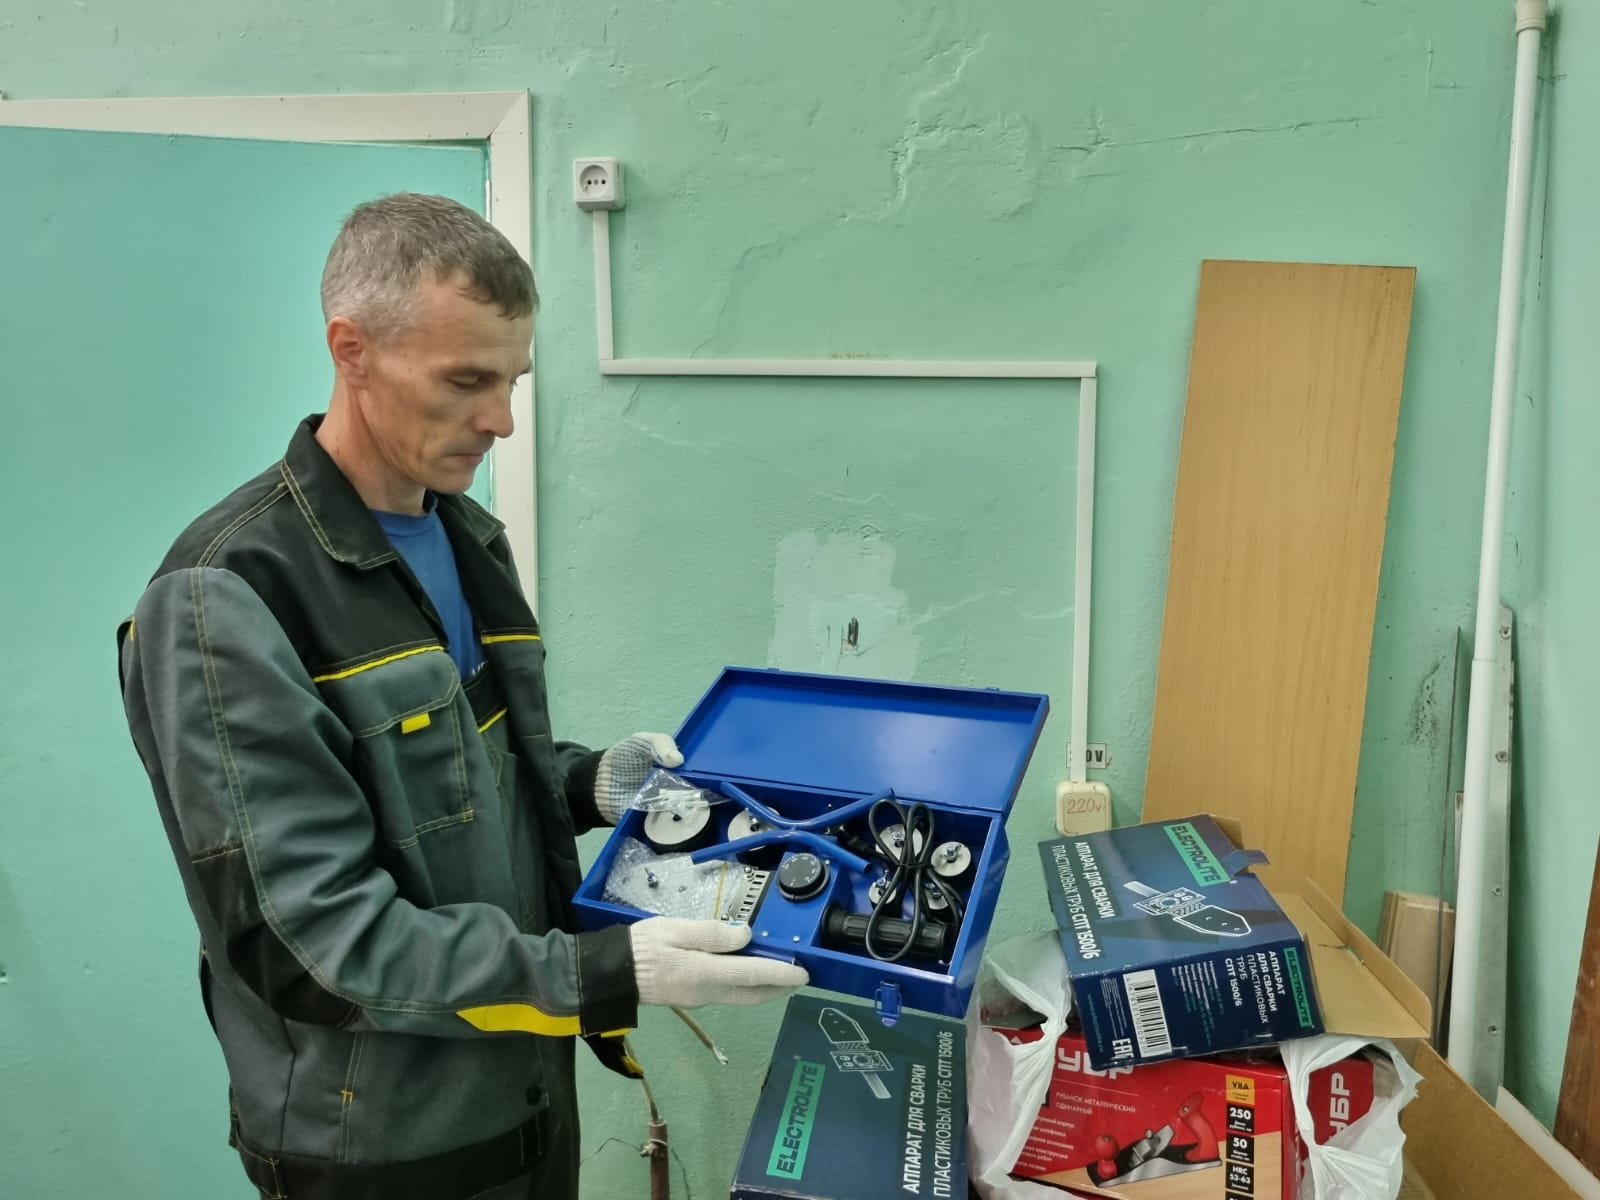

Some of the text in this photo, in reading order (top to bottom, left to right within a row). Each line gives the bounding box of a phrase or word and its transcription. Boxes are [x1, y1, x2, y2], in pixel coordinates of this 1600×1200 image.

[1074, 842, 1116, 919] АППАРАТ ДЛЯ СВАРКИ
[1171, 825, 1222, 882] ELECTROLITE
[1051, 844, 1101, 960] ПЛАСТИКОВЫХ ТРУБ СПТ 1500/6
[1225, 957, 1243, 1007] СПТ 1500/6
[1236, 955, 1248, 980] ТРУБ
[1246, 954, 1269, 1024] ПЛАСТИКОВЫХ
[1256, 952, 1278, 1012] ДЛЯ СВАРКИ
[1268, 950, 1285, 995] АППАРАТ
[1286, 951, 1310, 1024] ELECTROLITE
[776, 1064, 818, 1174] ELECTROLITE
[902, 1063, 927, 1195] АППАРАТ ДЛЯ СВАРКИ
[933, 1030, 954, 1198] ПЛАСТИКОВЫХ ТРУБ СПТ 1500/6
[1055, 1091, 1136, 1114] РУБАНОК МЕТАЛЛИЧЕСКИЙ
[1230, 1107, 1251, 1120] 250
[1233, 1137, 1248, 1149] 50
